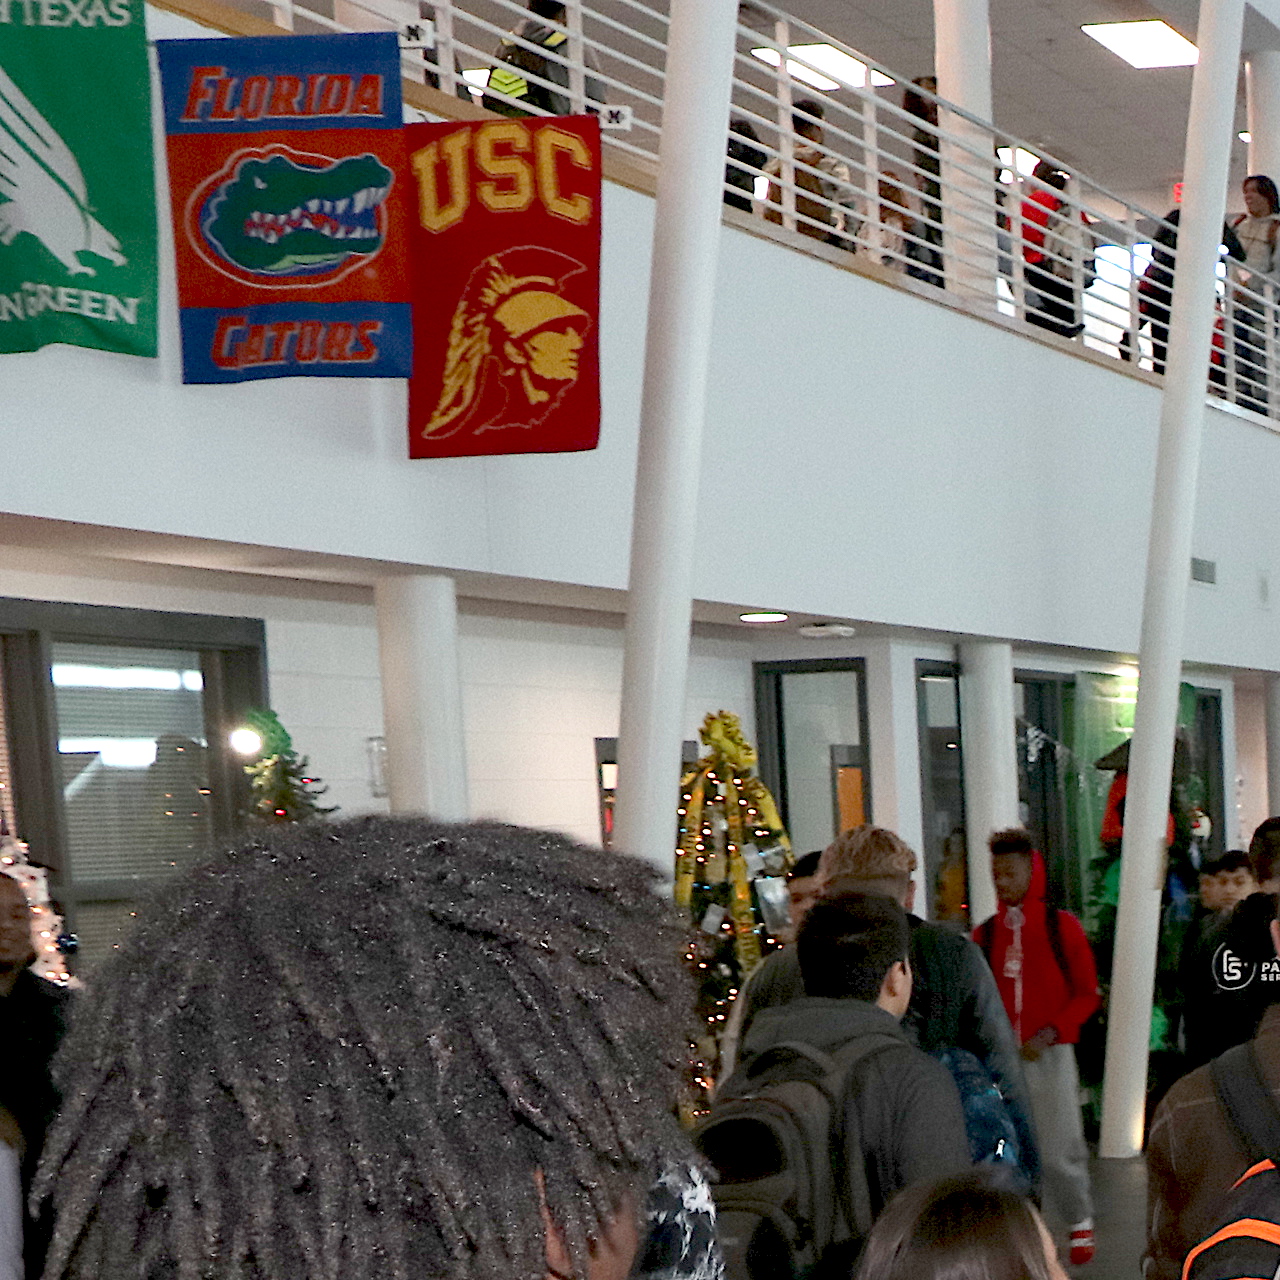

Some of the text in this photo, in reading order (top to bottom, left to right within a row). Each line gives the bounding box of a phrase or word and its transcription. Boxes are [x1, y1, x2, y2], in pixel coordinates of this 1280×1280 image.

[180, 66, 385, 122] FLORIDA
[409, 120, 594, 234] USC
[21, 281, 140, 325] GREEN
[211, 315, 383, 371] GATORS
